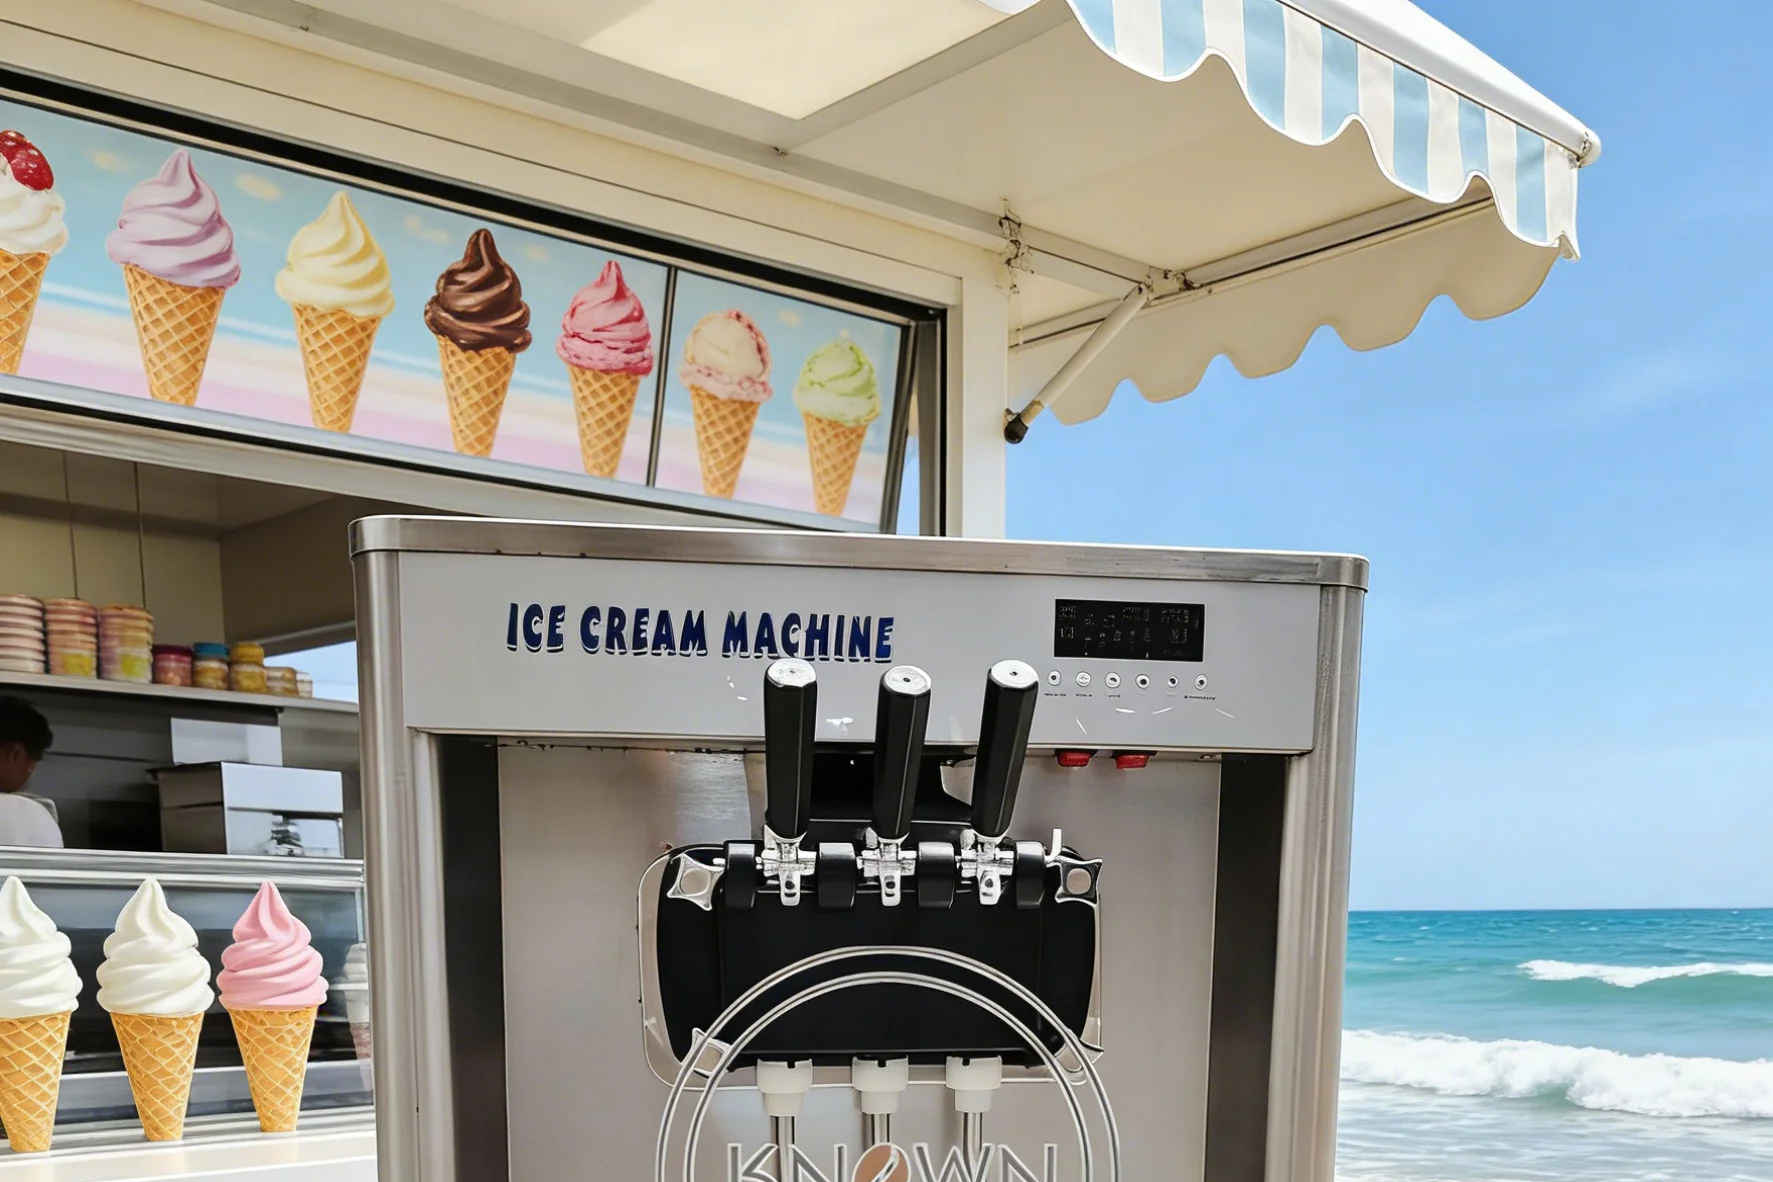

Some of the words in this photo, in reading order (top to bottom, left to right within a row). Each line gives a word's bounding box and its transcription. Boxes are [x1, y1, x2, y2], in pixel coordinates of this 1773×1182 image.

[506, 602, 566, 653] ICE
[579, 605, 708, 656] CREAM
[721, 610, 895, 663] MACHINE
